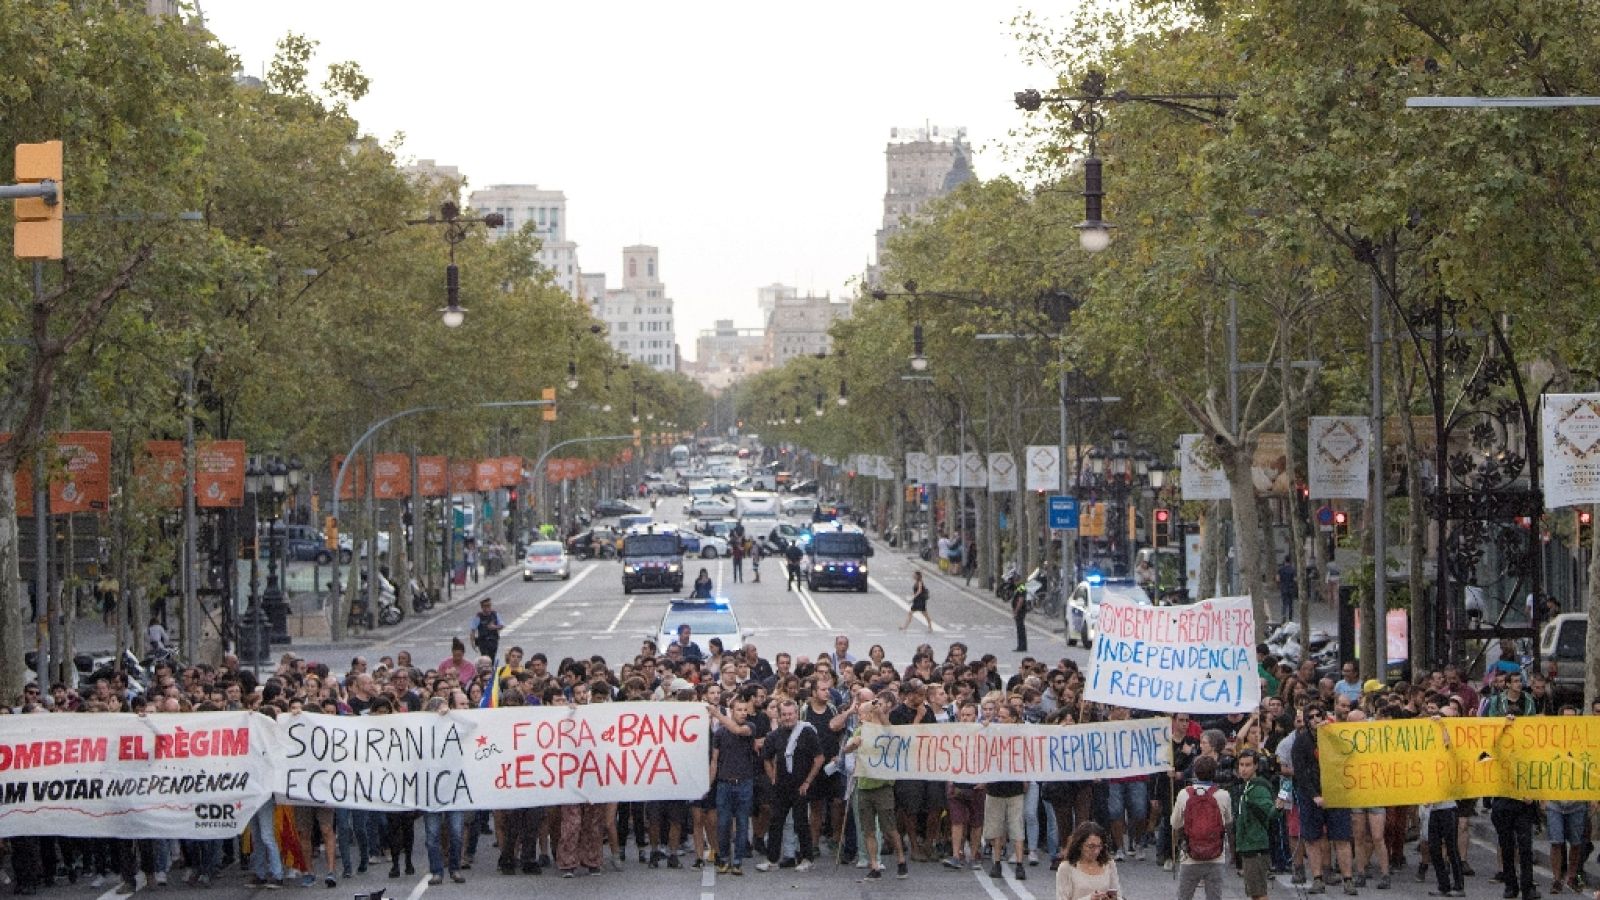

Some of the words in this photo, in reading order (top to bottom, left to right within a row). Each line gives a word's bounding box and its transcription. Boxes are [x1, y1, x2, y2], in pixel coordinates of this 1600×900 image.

[1156, 611, 1173, 643] EL
[1232, 608, 1253, 648] 78
[118, 735, 149, 761] EL
[154, 726, 249, 760] RÈGIM
[286, 722, 463, 763] SOBIRANIA
[513, 718, 597, 751] FORA
[601, 725, 615, 743] el
[618, 713, 701, 748] BANC
[1455, 724, 1515, 749] DRETS
[1521, 722, 1600, 750] SOCIAL
[869, 734, 912, 773] SOM
[915, 734, 1047, 775] TOSSUDAMENT
[1343, 760, 1425, 790] SERVEIS
[1516, 753, 1600, 791] REPÚBLIC
[0, 782, 28, 804] M
[33, 778, 104, 801] VOTAR
[106, 769, 250, 798] INDEPENDÈNCIA
[285, 768, 474, 806] ECONÒMICA
[195, 803, 235, 820] CDR
